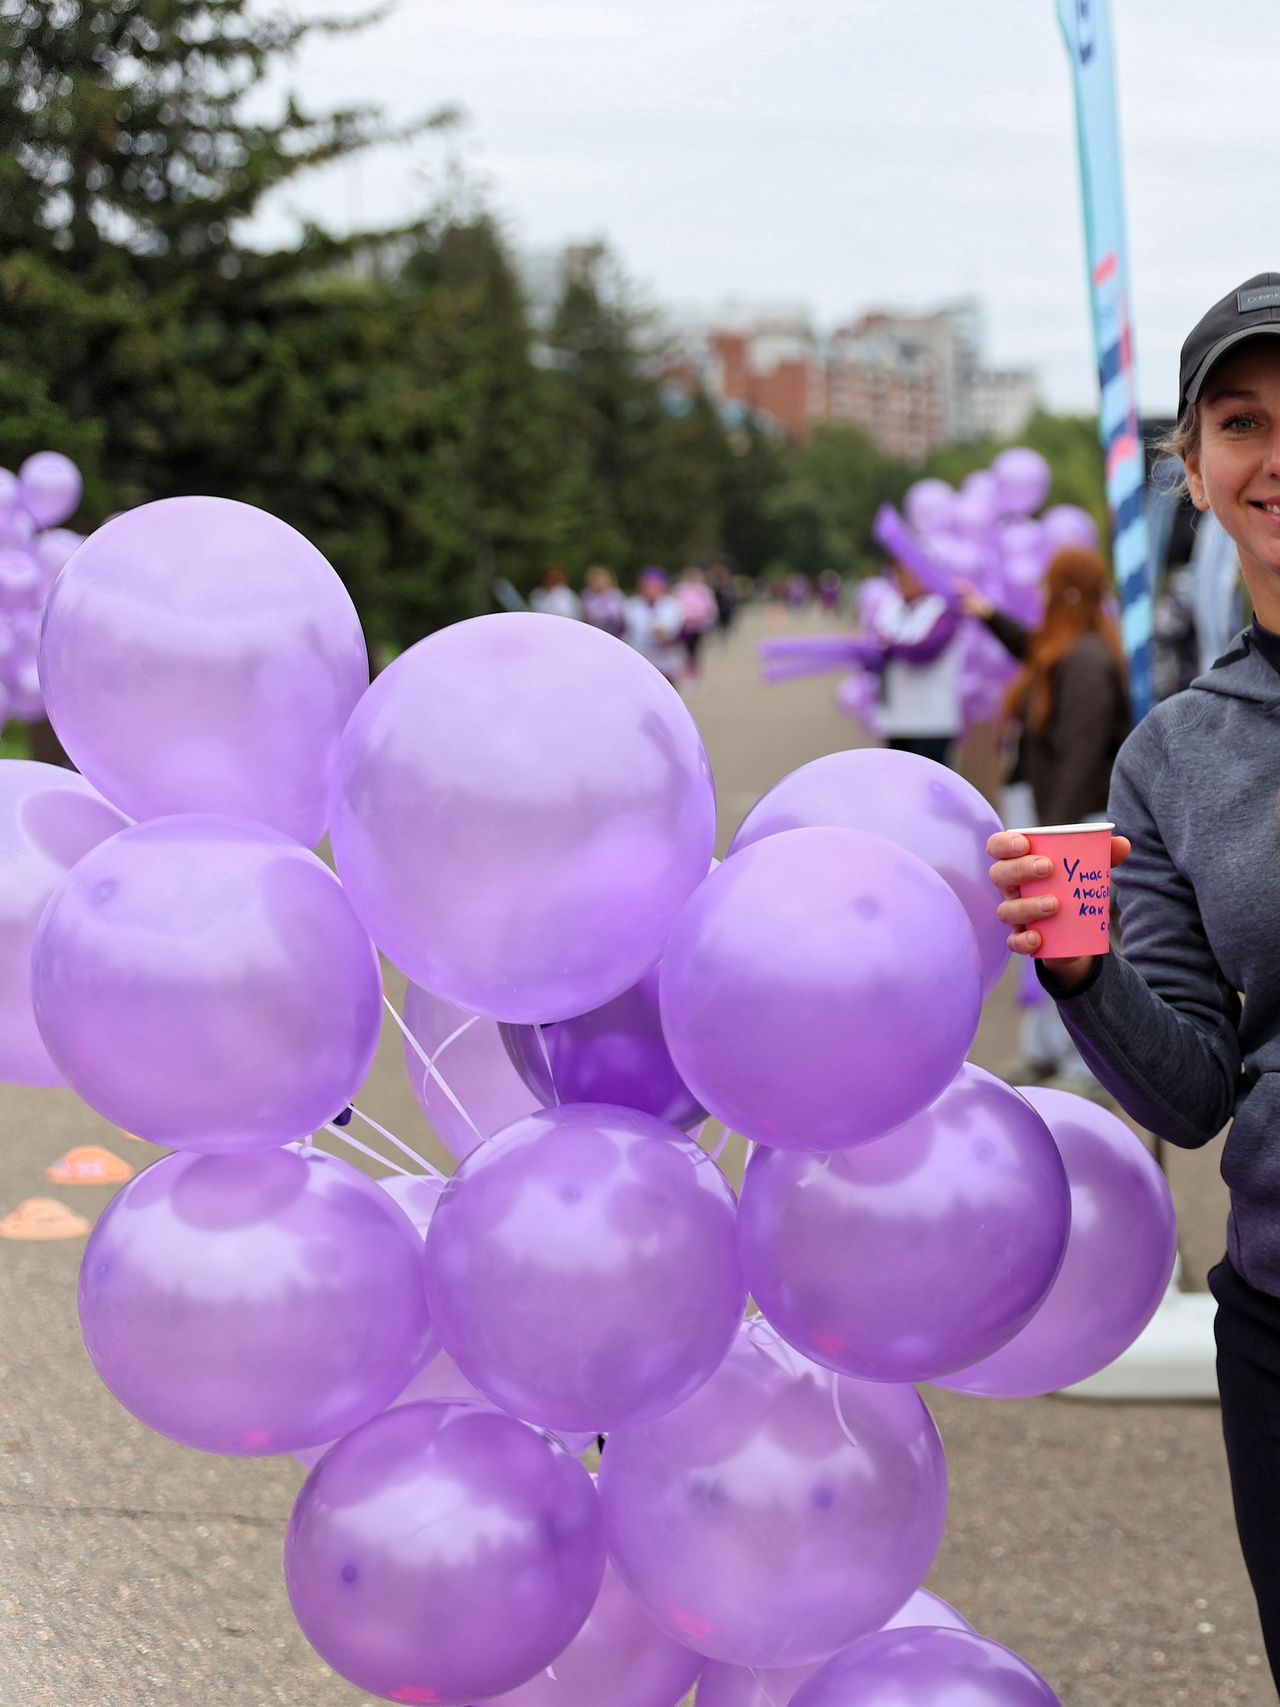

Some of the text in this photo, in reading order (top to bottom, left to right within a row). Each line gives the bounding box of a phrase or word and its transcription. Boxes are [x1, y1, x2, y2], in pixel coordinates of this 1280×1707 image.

[1247, 293, 1274, 303] Calvin
[1063, 857, 1080, 882] У
[1079, 870, 1103, 882] нас
[1079, 902, 1104, 916] как
